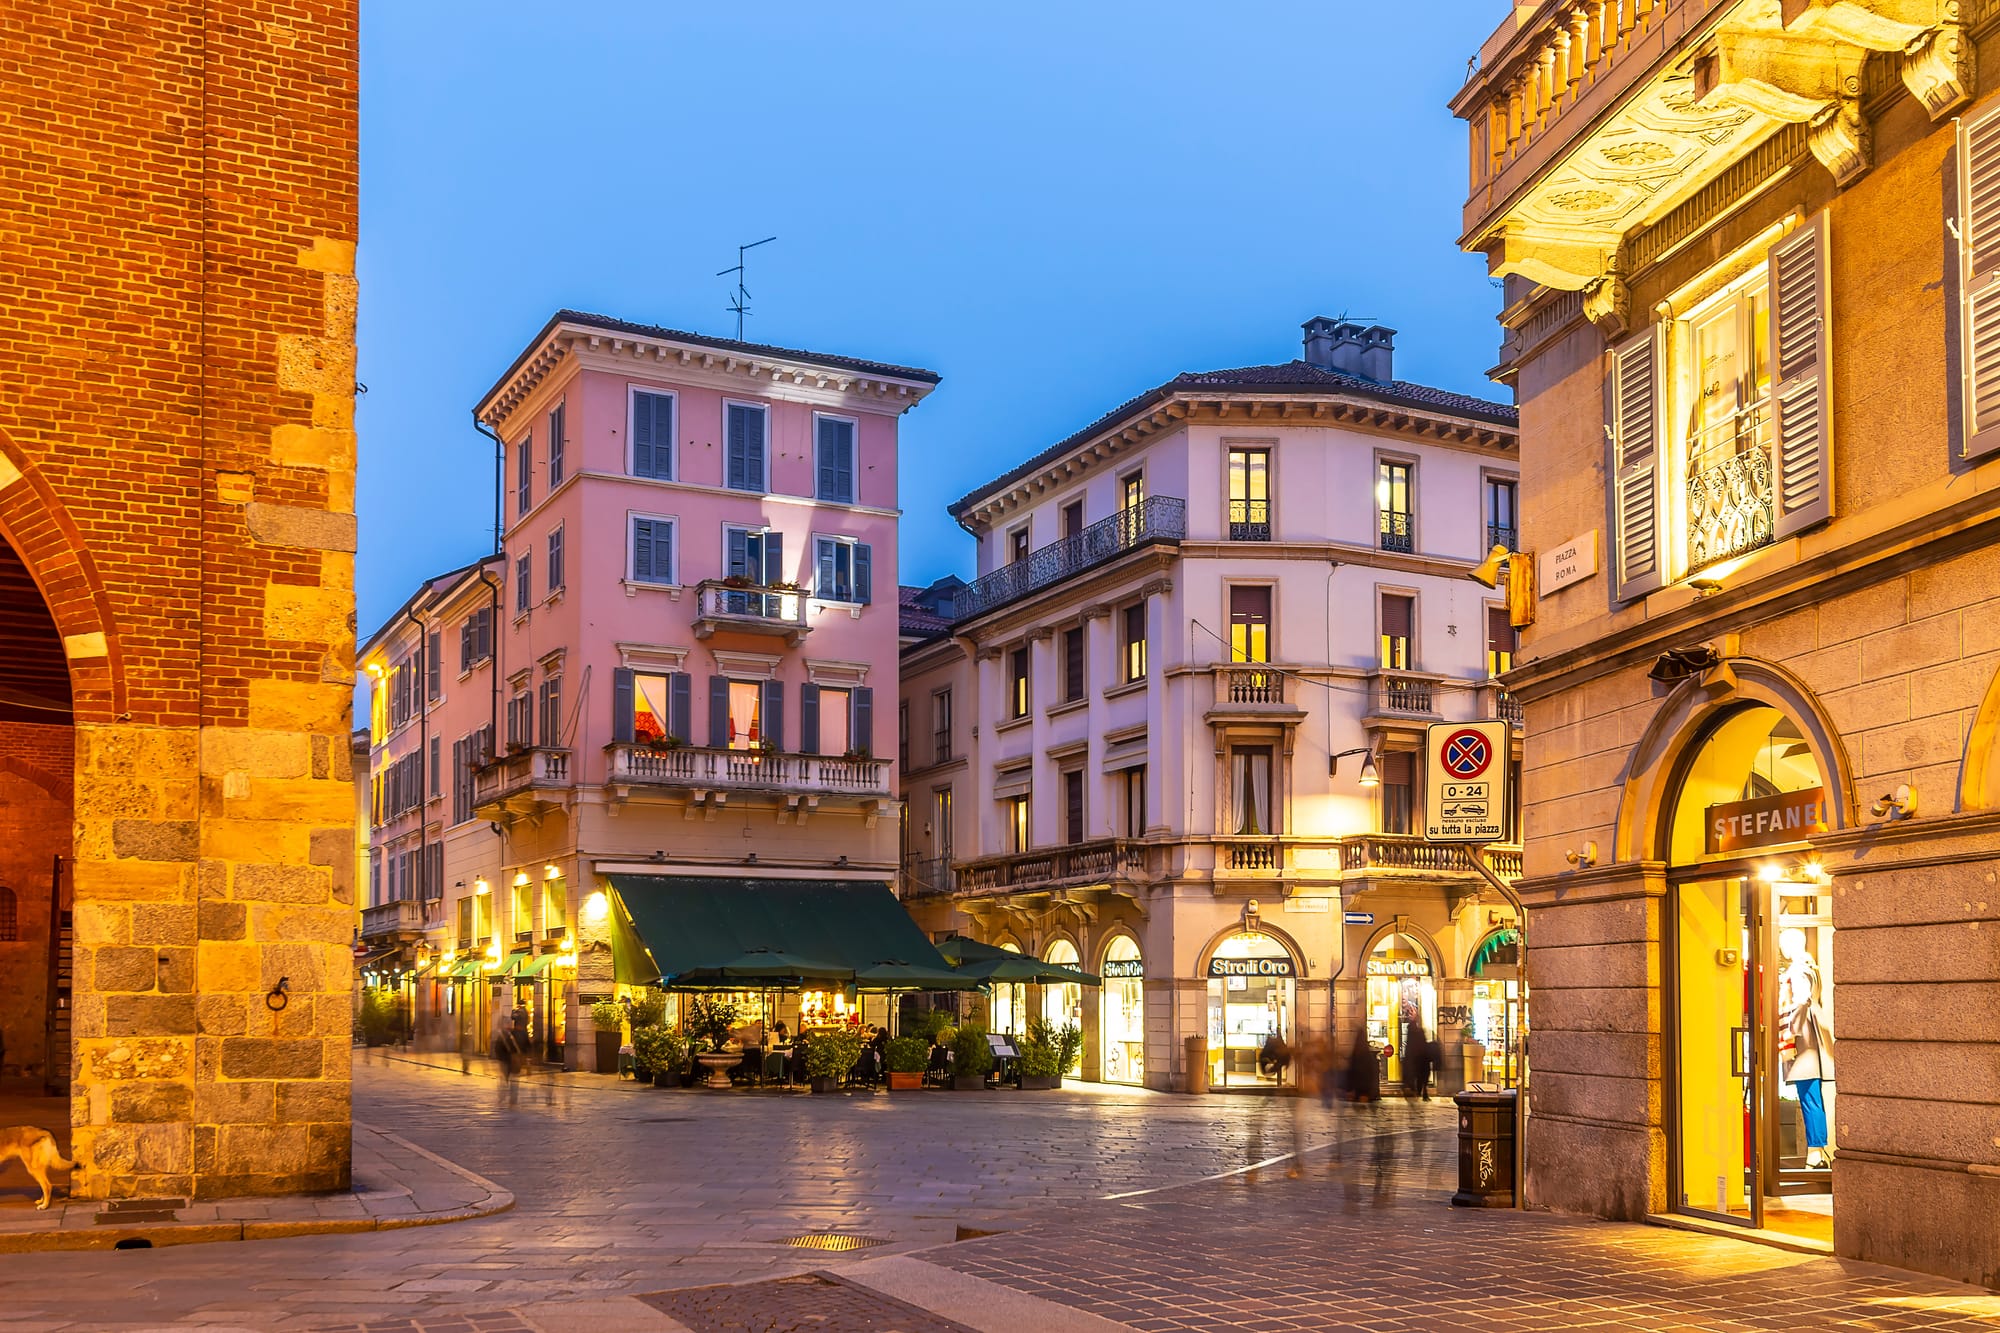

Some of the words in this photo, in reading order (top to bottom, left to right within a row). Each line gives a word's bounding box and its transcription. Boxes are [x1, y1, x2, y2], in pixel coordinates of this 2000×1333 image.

[1555, 547, 1577, 564] PIAZZA
[1555, 565, 1577, 581] ROMA
[1448, 786, 1457, 796] 0
[1466, 785, 1482, 796] 24
[1429, 826, 1438, 834] su
[1442, 824, 1461, 834] tutta
[1464, 823, 1471, 834] la
[1475, 823, 1499, 835] piazza
[1212, 959, 1258, 975] Stroili
[1259, 959, 1290, 975] Oro
[1404, 960, 1428, 975] Oro
